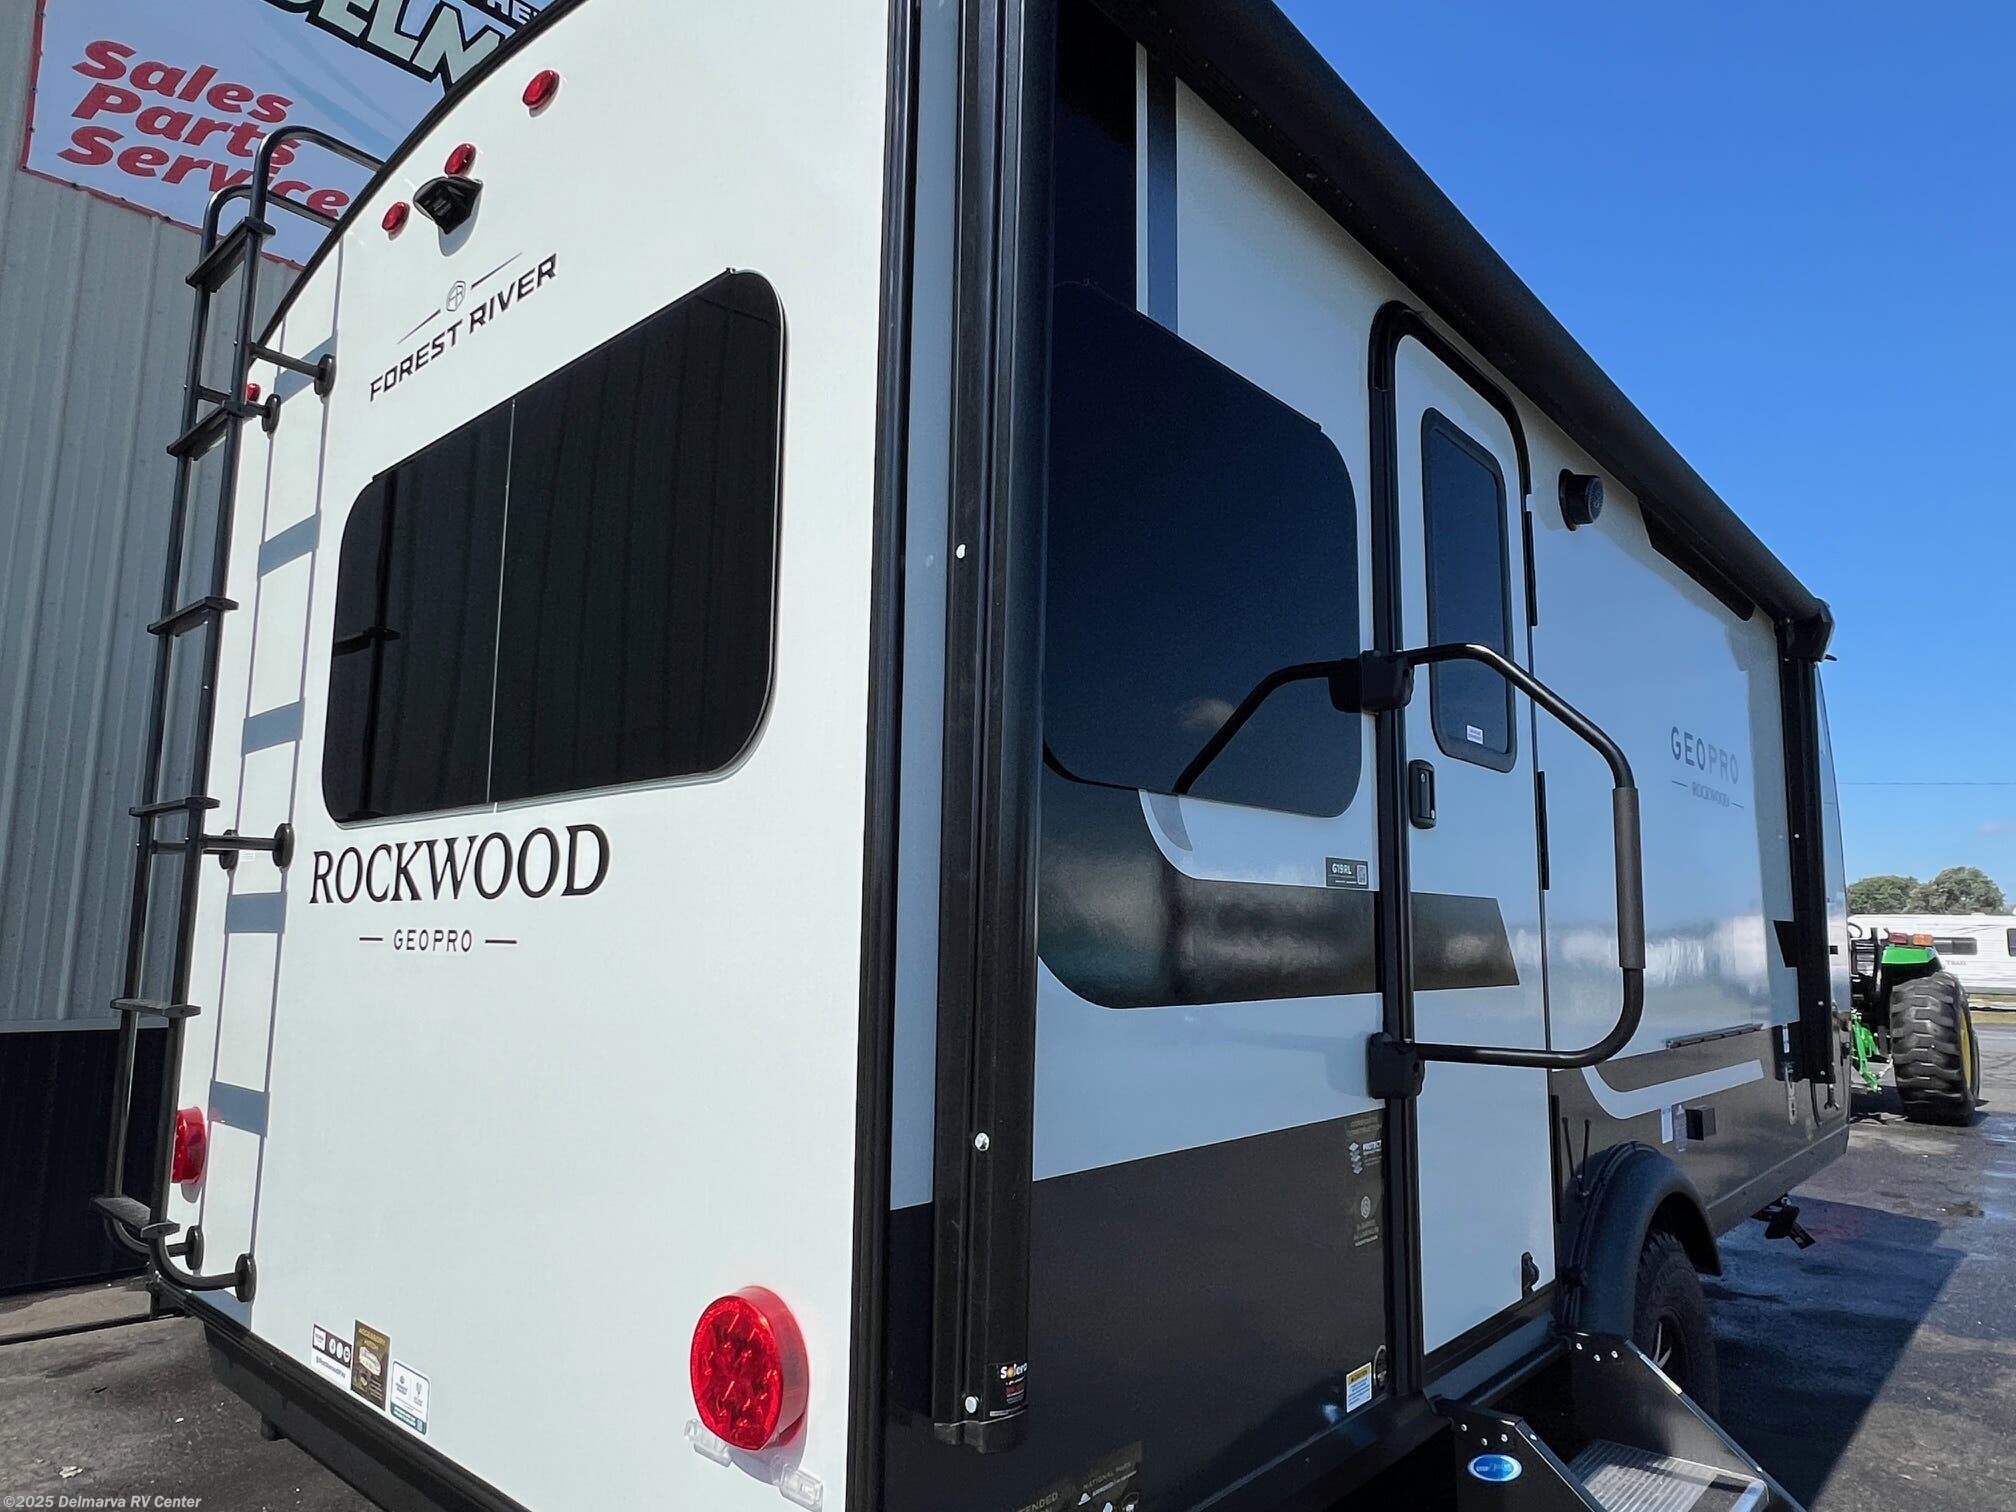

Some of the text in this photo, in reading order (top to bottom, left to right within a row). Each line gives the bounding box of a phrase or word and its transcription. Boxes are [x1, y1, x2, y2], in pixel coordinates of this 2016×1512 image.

[72, 40, 293, 123] Sales
[57, 126, 350, 217] Servce
[370, 253, 557, 402] FOREST RIVER
[1671, 726, 1739, 784] GEOPRO
[309, 823, 611, 904] ROCKWOOD
[393, 929, 473, 952] GEOPRO
